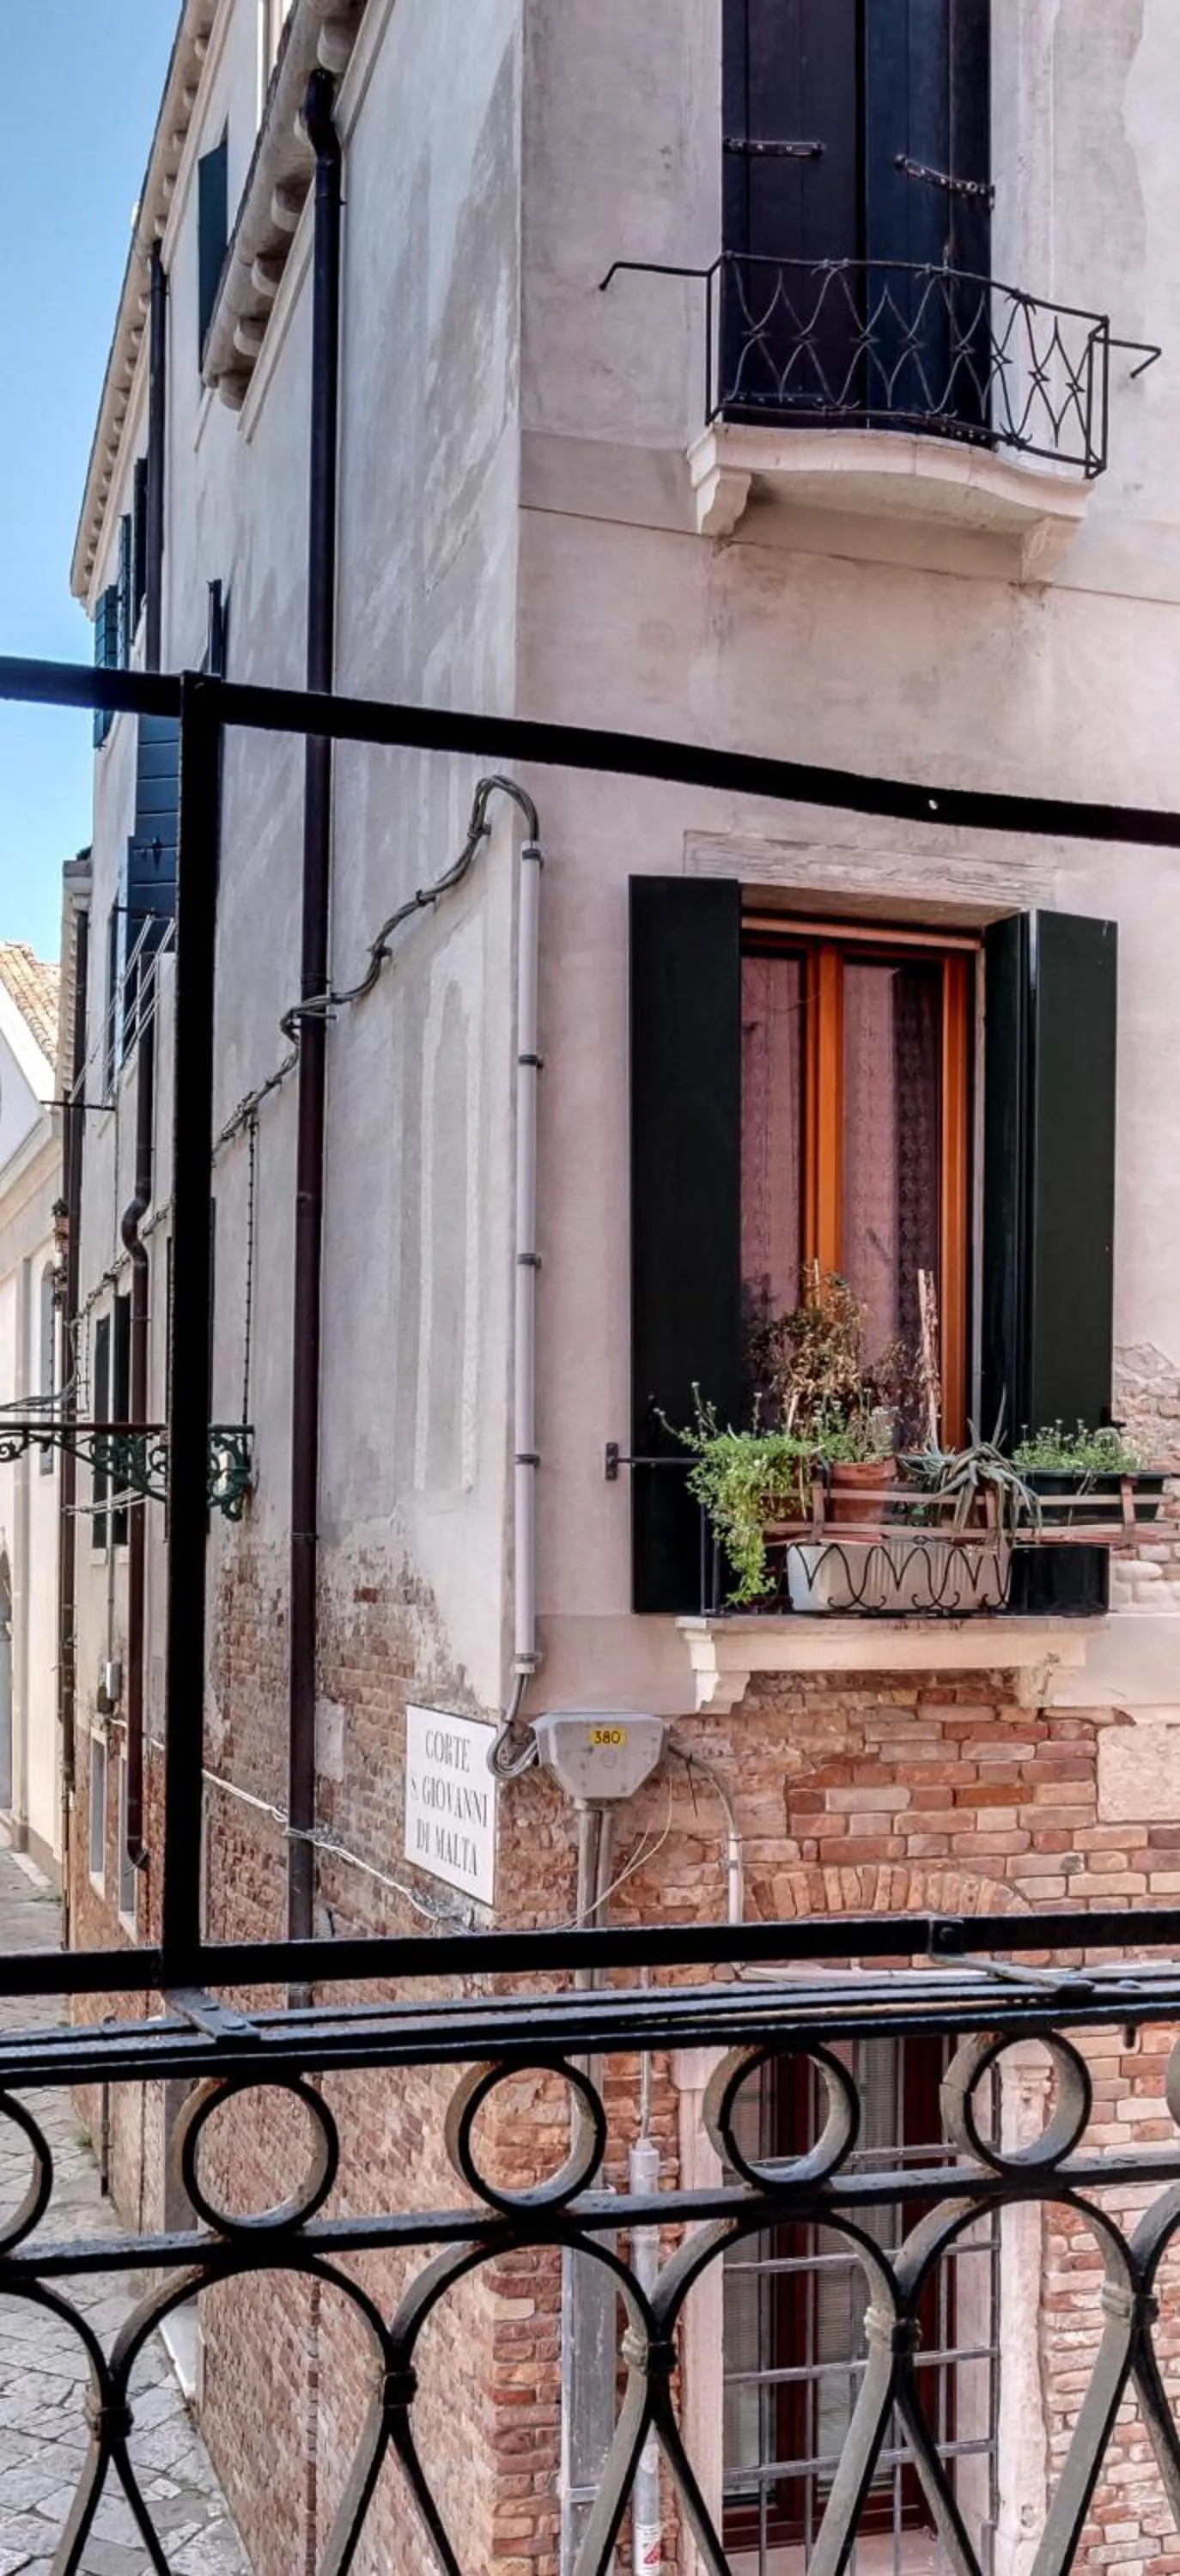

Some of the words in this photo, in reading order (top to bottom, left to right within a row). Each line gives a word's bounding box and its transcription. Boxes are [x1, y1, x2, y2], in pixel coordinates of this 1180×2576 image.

[425, 1730, 471, 1772] CORTE
[593, 1730, 621, 1745] 380
[422, 1776, 487, 1827] GIOVANNI
[417, 1819, 430, 1853] DI
[435, 1826, 477, 1876] MALTA
